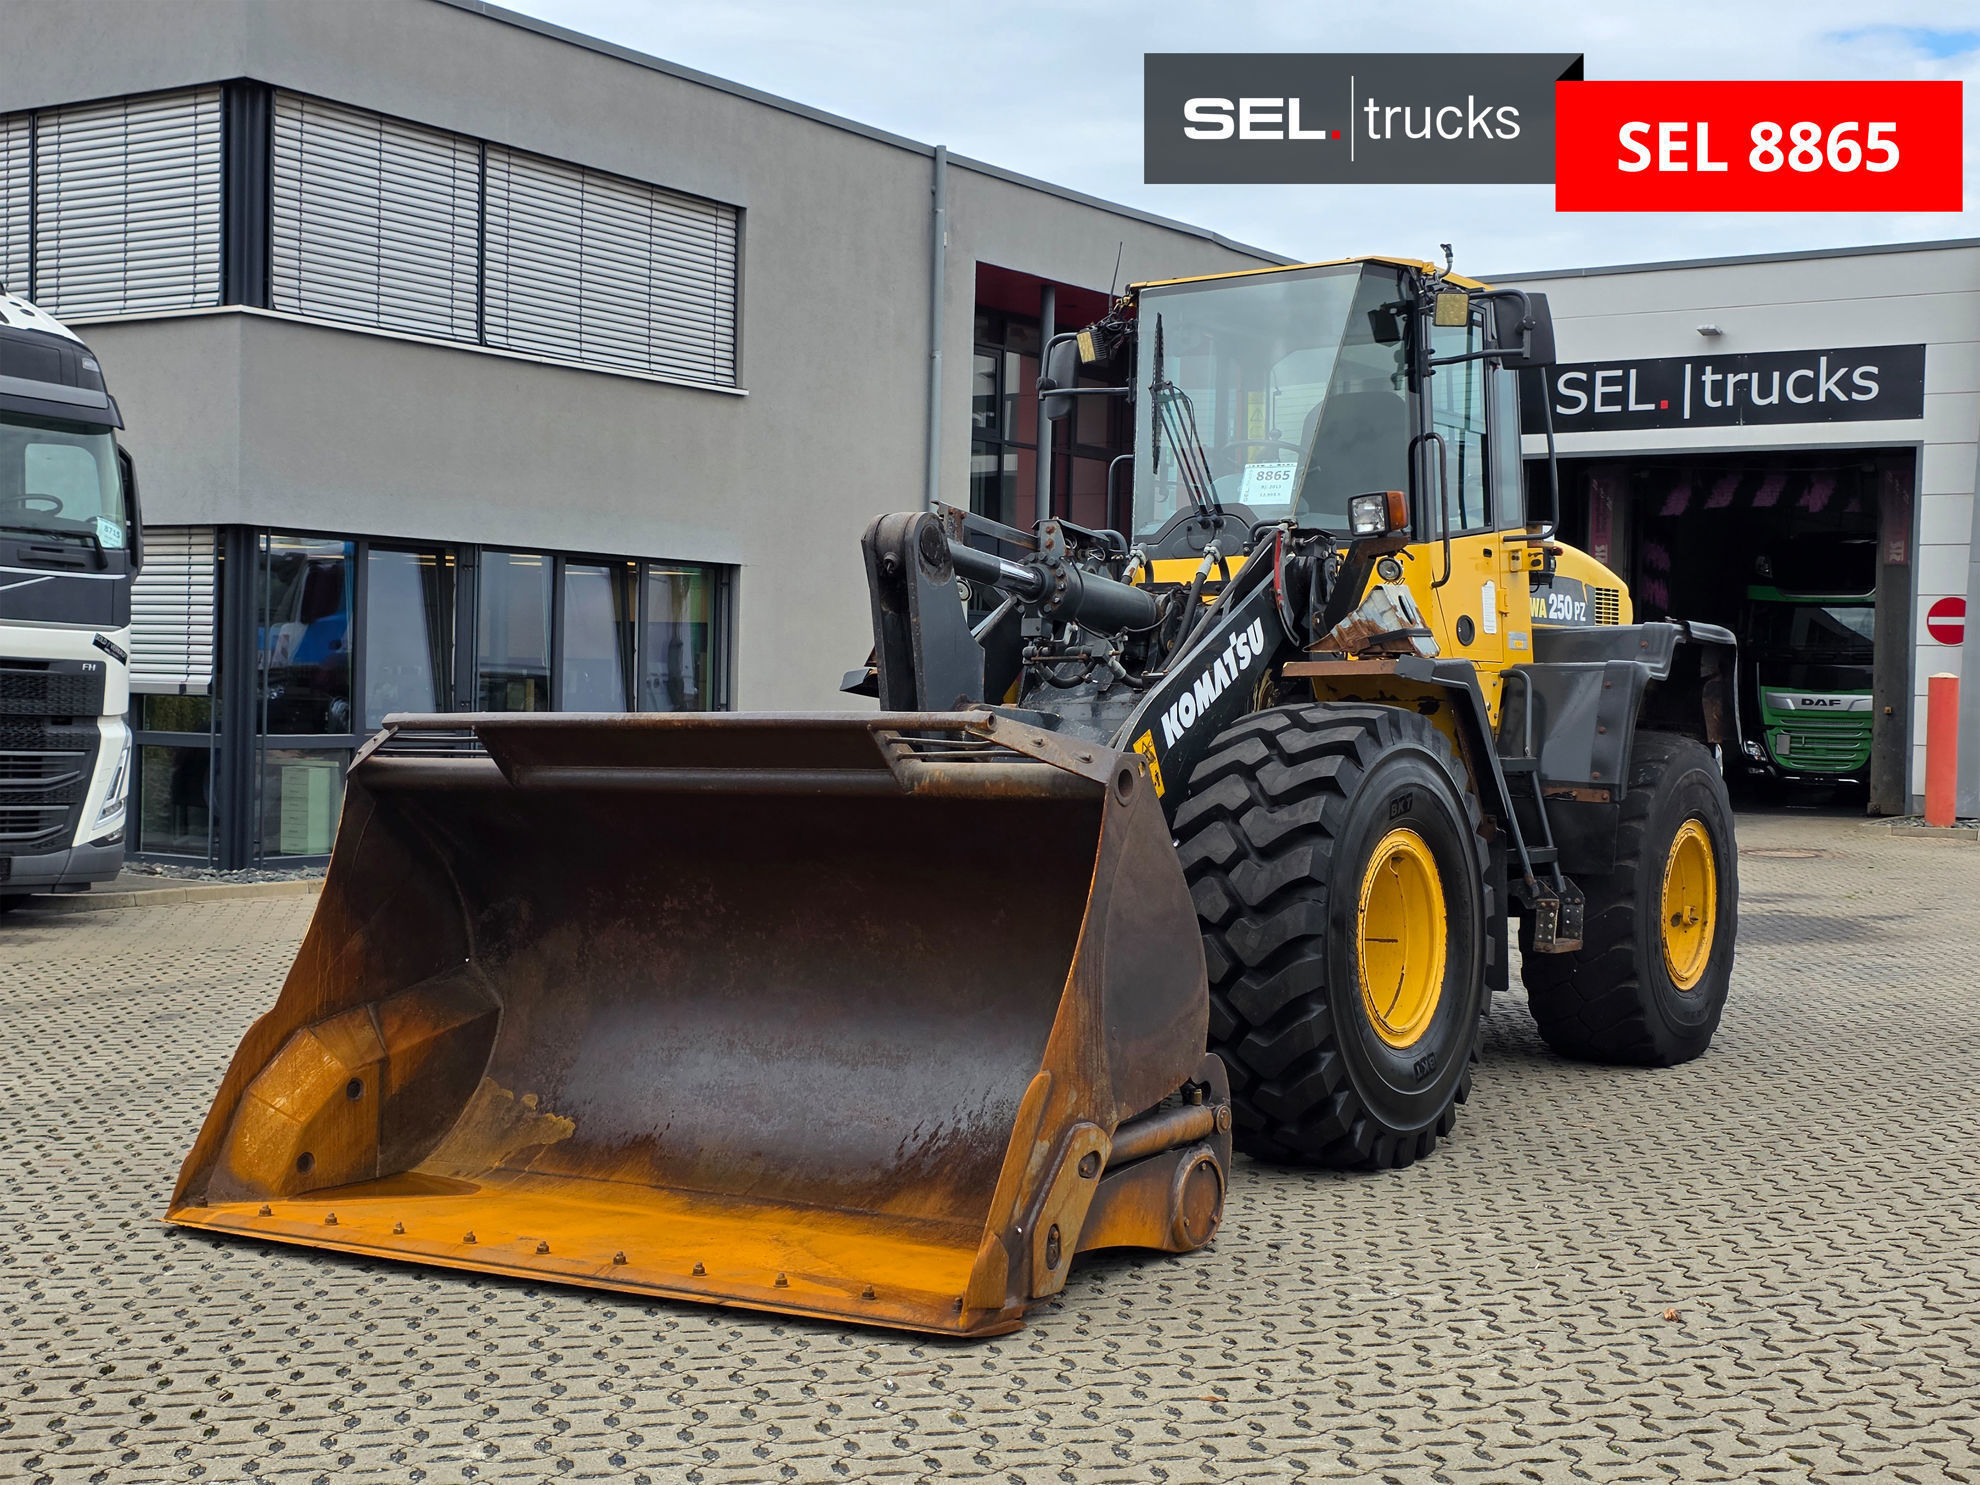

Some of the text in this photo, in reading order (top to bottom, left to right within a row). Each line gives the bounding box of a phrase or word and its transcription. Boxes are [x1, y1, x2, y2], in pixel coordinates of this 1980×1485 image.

[1701, 356, 1880, 408] trucks
[1256, 470, 1291, 481] 8865
[1530, 593, 1587, 622] WA 250 PZ
[82, 663, 97, 672] FH
[1160, 616, 1265, 750] KOMATSU
[1801, 698, 1841, 706] DAF
